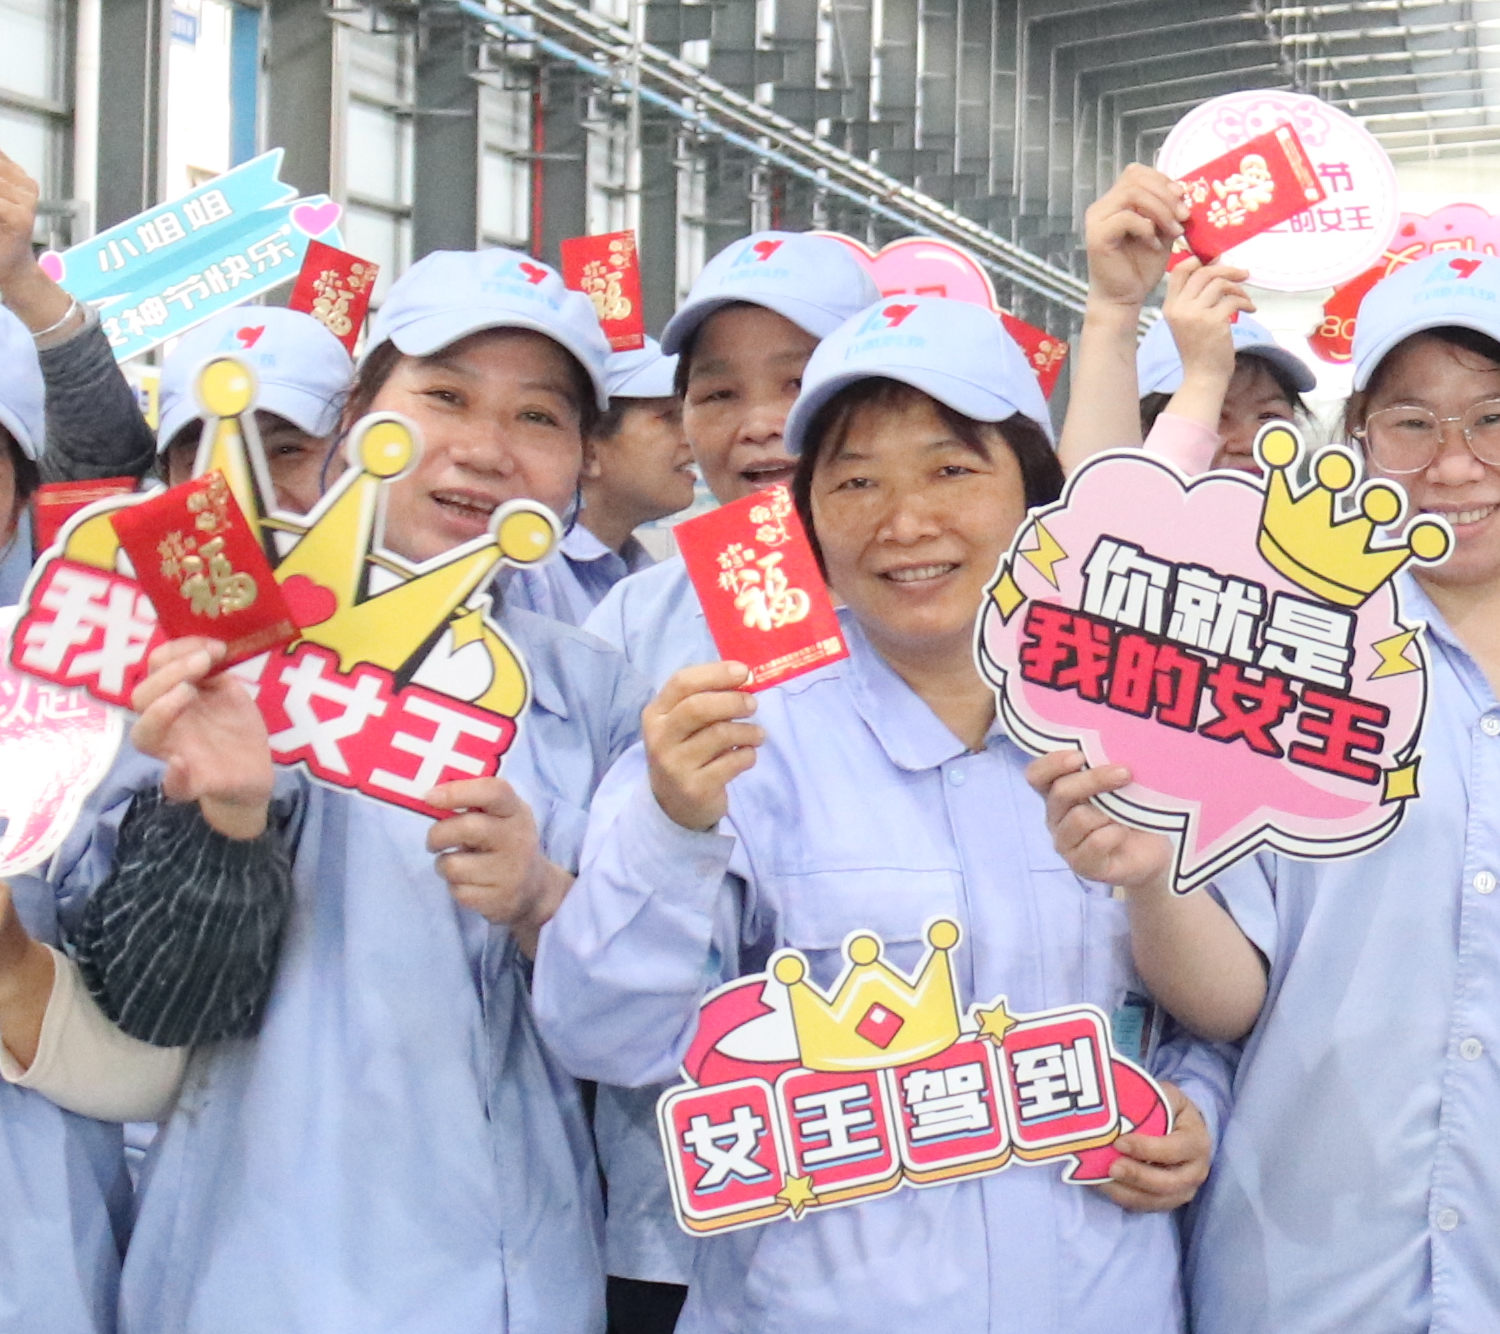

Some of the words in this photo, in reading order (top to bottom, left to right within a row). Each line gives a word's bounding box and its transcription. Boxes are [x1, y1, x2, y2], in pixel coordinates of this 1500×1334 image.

[97, 189, 233, 272] 小姐姐
[102, 222, 297, 347] 女神节快乐
[179, 535, 258, 620] 福
[733, 551, 811, 632] 福
[1084, 537, 1355, 691] 你就是
[21, 566, 501, 803] 我女王
[1021, 603, 1389, 785] 我的女王
[683, 1037, 1100, 1190] 女王驾到
